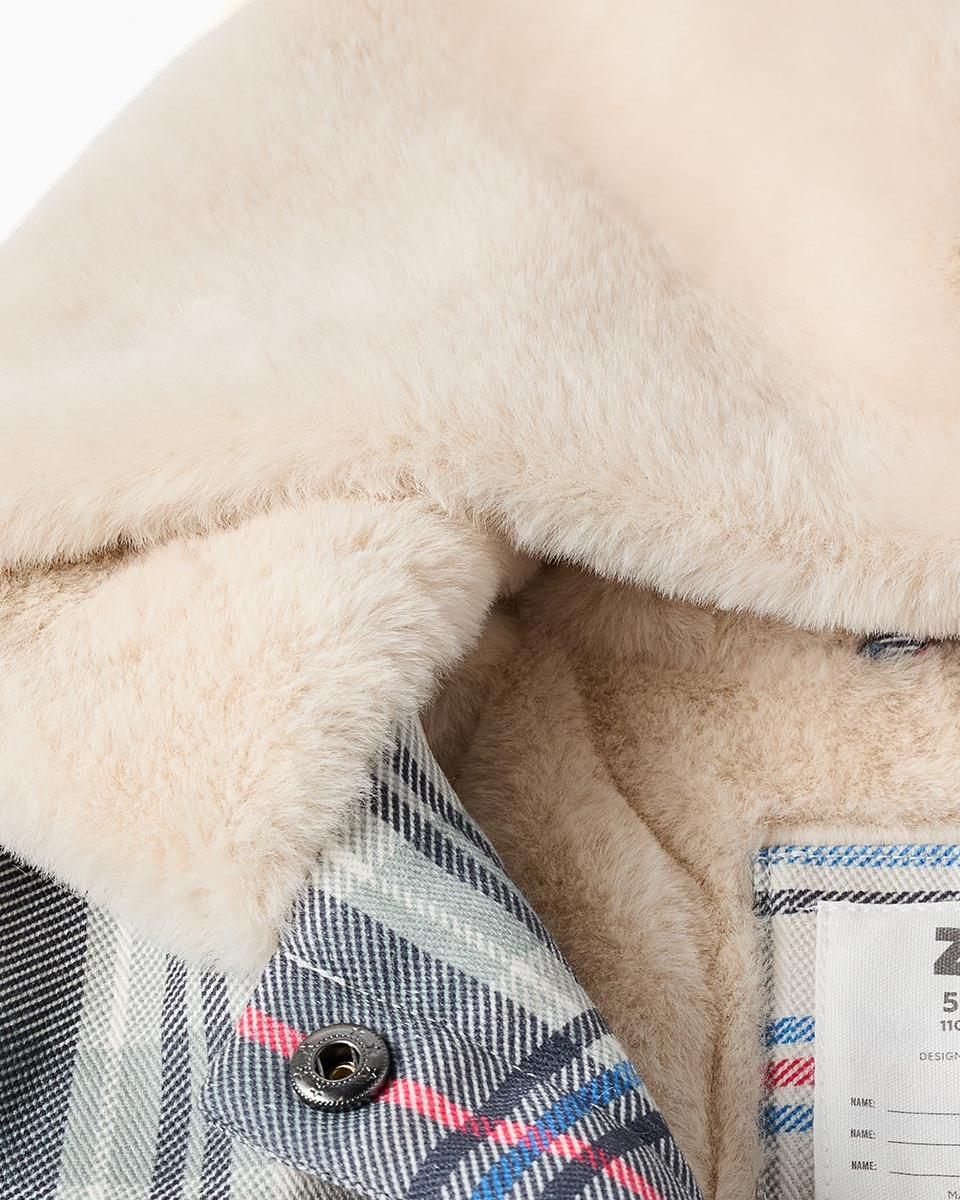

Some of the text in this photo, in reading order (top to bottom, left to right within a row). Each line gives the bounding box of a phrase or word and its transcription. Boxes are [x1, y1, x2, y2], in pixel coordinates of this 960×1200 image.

[851, 1098, 876, 1107] NAME:
[851, 1129, 876, 1139] NAME:
[851, 1161, 877, 1171] NAME:
